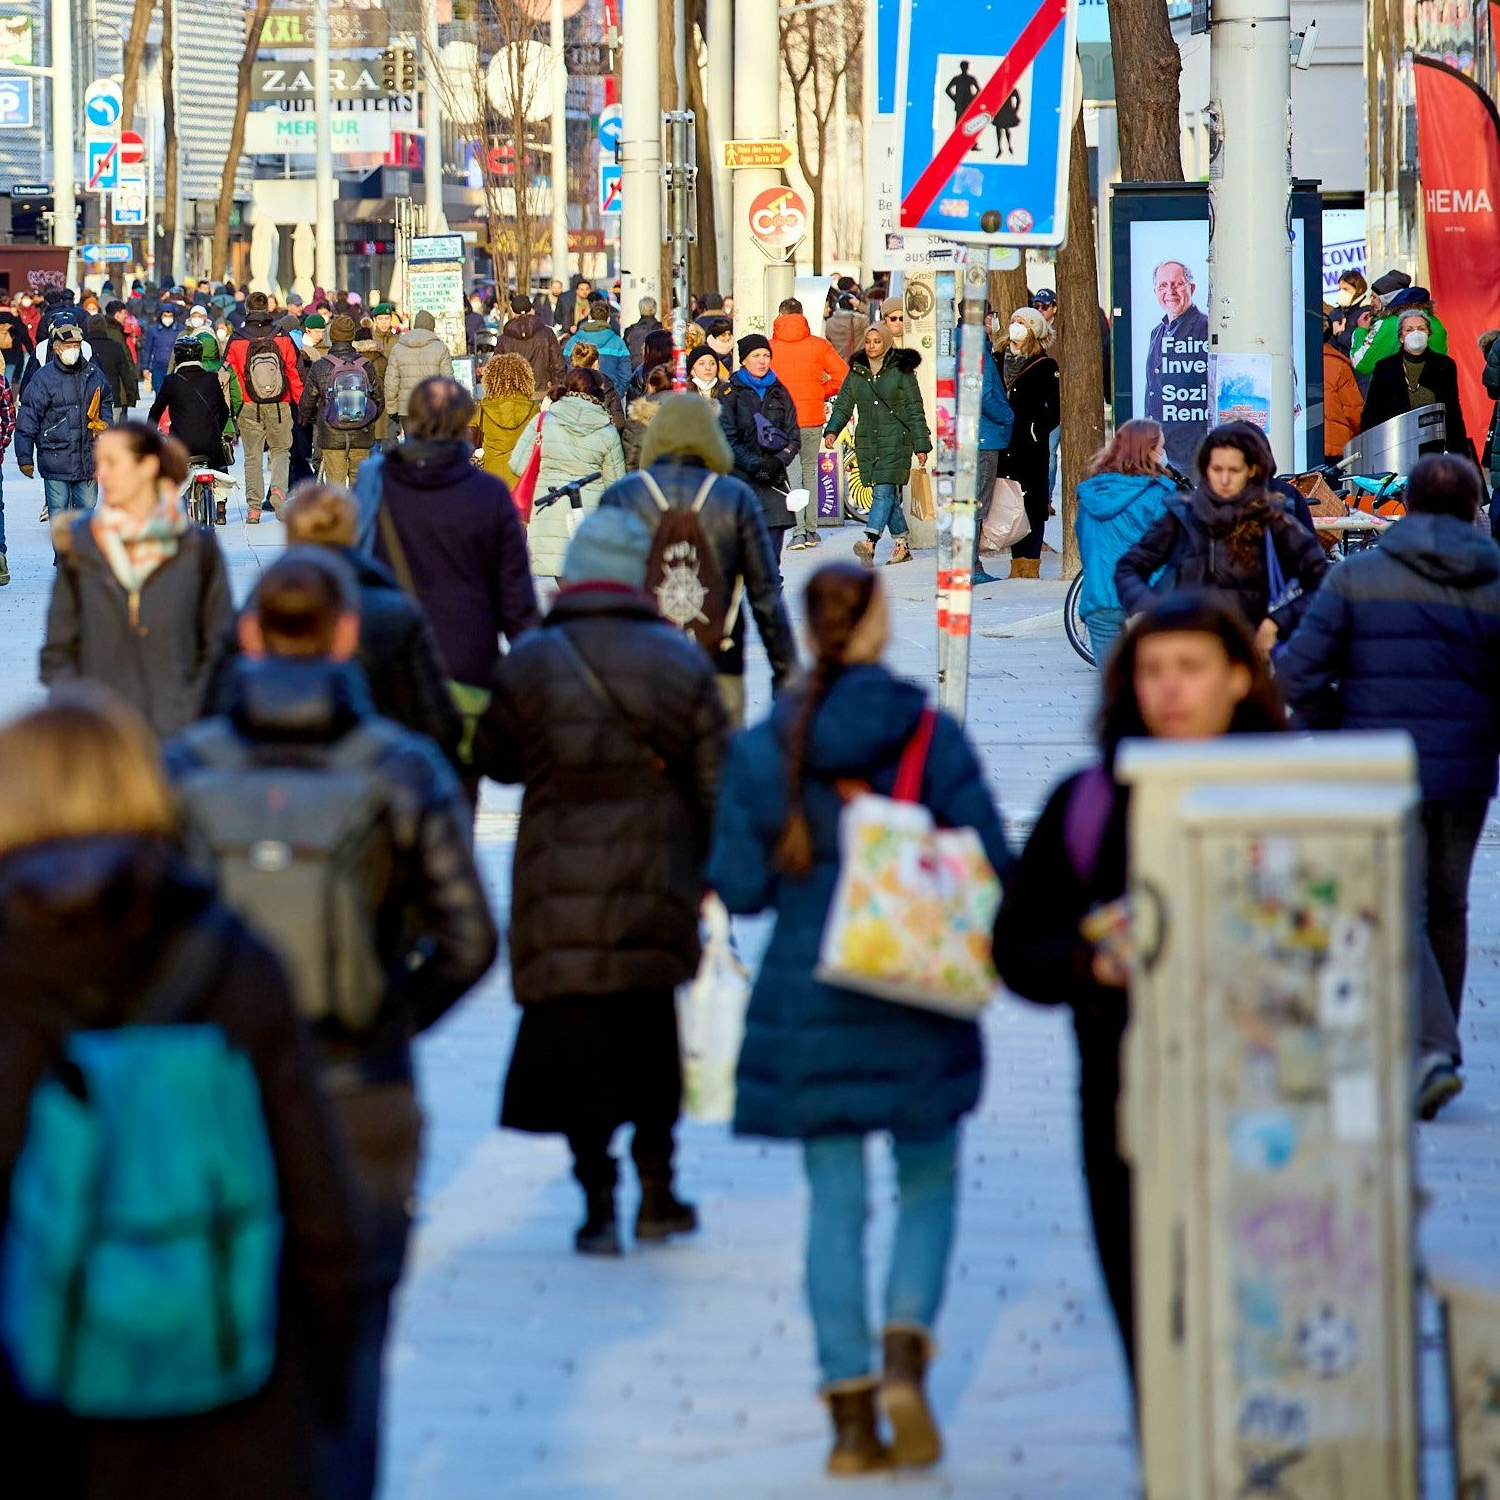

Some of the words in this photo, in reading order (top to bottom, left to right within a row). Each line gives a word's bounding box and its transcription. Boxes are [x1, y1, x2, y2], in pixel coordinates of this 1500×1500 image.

[261, 69, 381, 92] ZARA
[277, 121, 359, 136] MERUR
[1427, 189, 1492, 213] HEMA
[1161, 357, 1208, 374] Inve
[1161, 384, 1207, 402] Sozi
